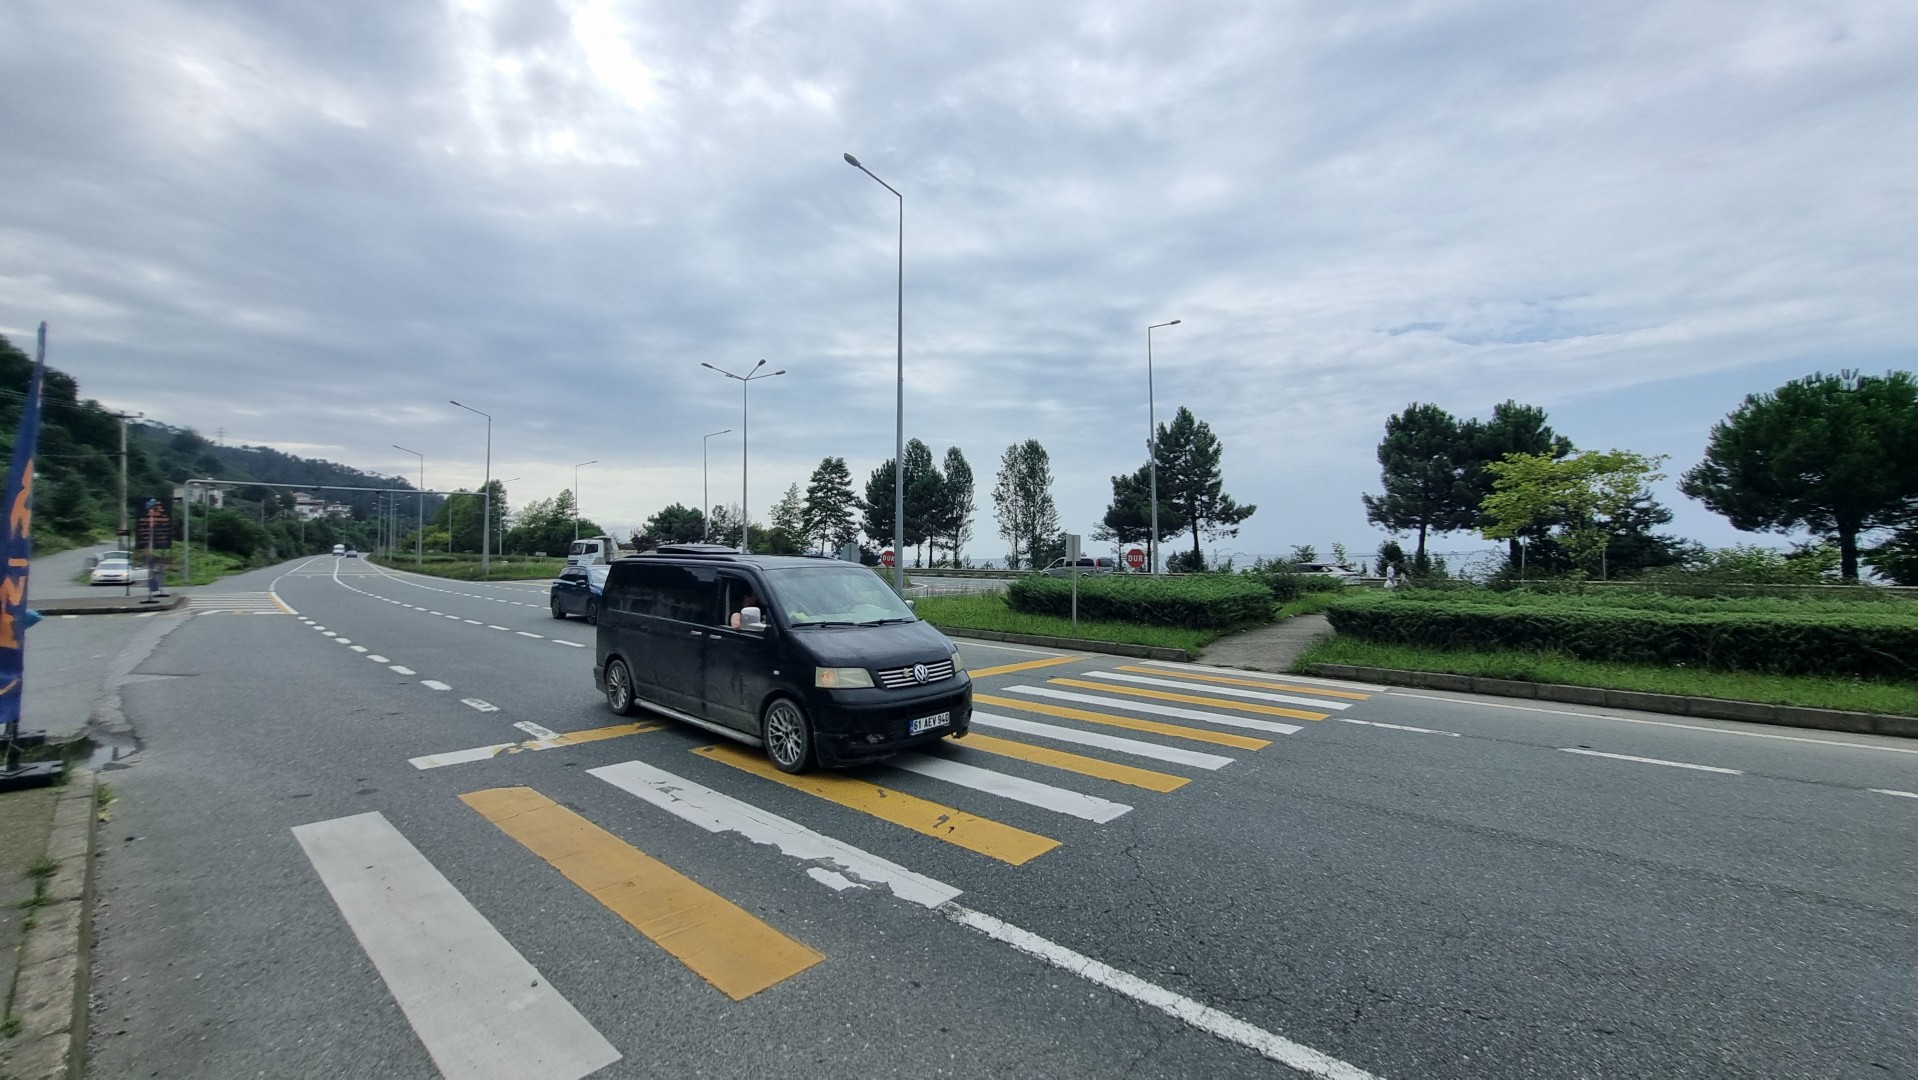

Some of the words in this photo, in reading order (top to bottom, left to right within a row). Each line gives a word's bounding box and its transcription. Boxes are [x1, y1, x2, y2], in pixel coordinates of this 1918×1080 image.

[1128, 554, 1143, 562] DUR
[913, 719, 922, 731] 61
[924, 716, 937, 728] AEV
